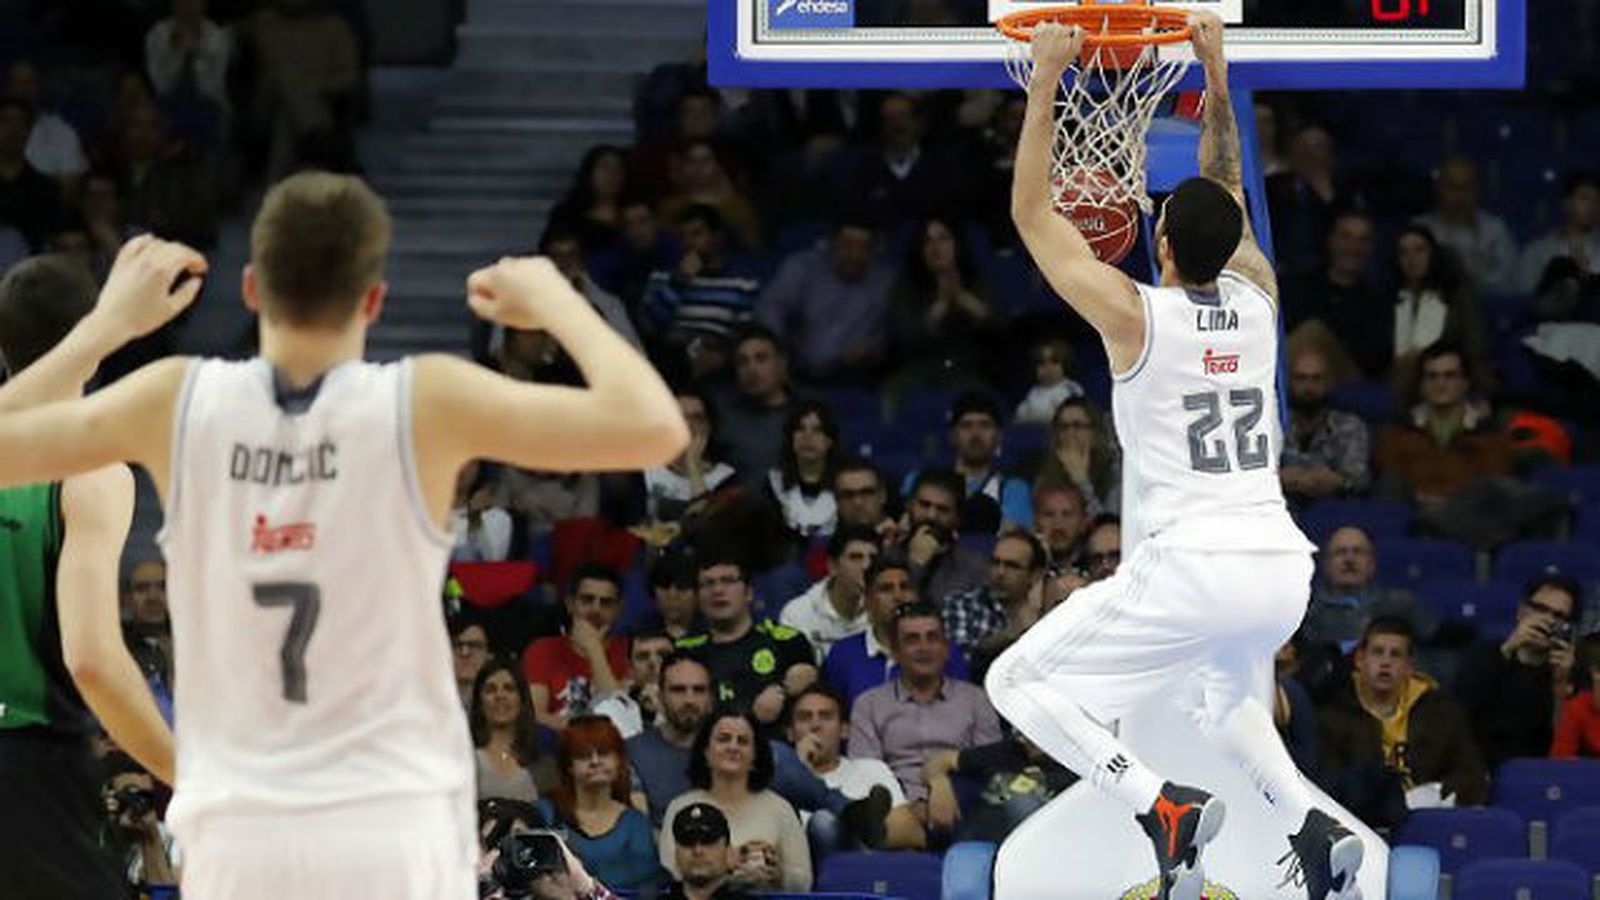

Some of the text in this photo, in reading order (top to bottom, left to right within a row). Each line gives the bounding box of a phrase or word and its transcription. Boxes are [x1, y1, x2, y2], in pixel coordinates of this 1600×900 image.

[1196, 309, 1239, 332] LIMA
[1182, 388, 1268, 473] 22
[252, 582, 321, 704] 7
